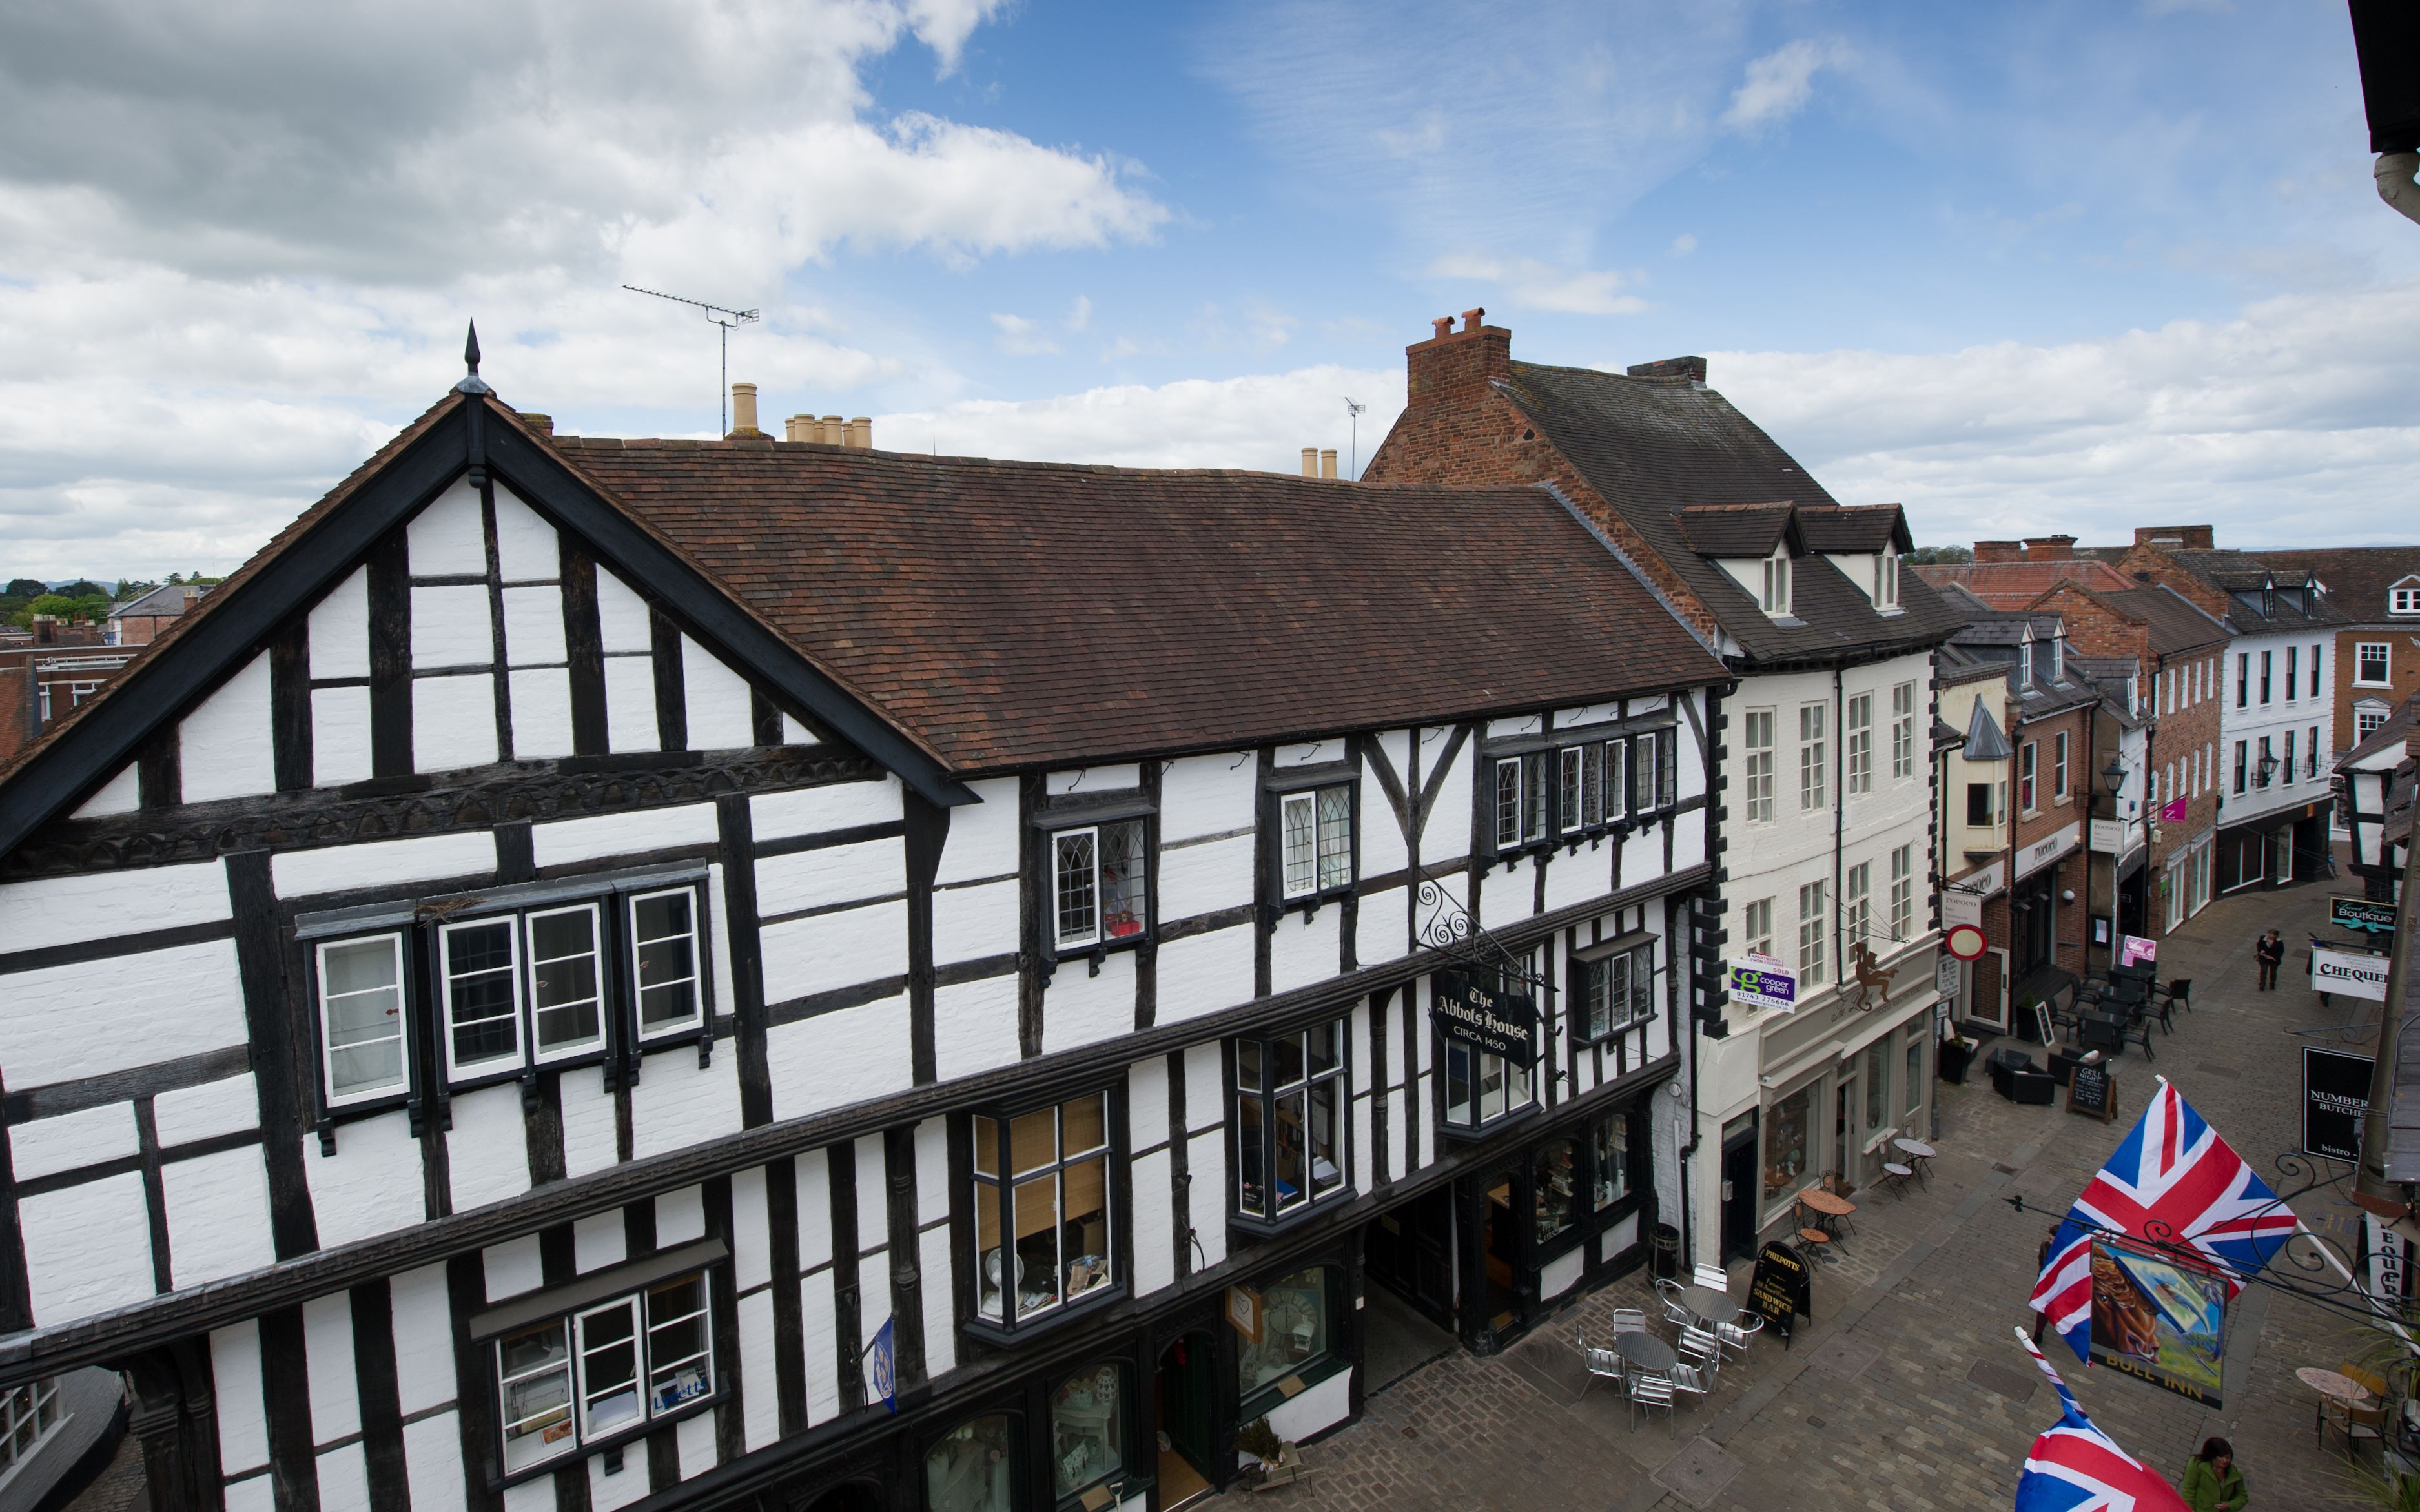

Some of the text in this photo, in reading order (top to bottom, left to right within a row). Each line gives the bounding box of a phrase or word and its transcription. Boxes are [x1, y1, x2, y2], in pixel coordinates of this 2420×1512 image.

[1946, 897, 1976, 907] rococo
[2339, 908, 2392, 922] Boutique
[1760, 977, 1789, 988] cooper
[1766, 984, 1789, 995] green
[1470, 986, 1493, 1008] The
[1737, 991, 1789, 1007] 01743 276666
[1484, 1010, 1528, 1041] House
[1453, 1025, 1506, 1051] CIRCA 1450
[2079, 1072, 2102, 1083] NIGHT
[2311, 1090, 2368, 1107] NUMBER
[2321, 1144, 2350, 1156] bistro
[1766, 1249, 1800, 1271] PHILPOTTS
[1753, 1287, 1793, 1313] SANDWICH
[1762, 1300, 1780, 1316] BAR
[2107, 1353, 2203, 1400] BULL INN
[654, 1379, 706, 1410] Lycetts
